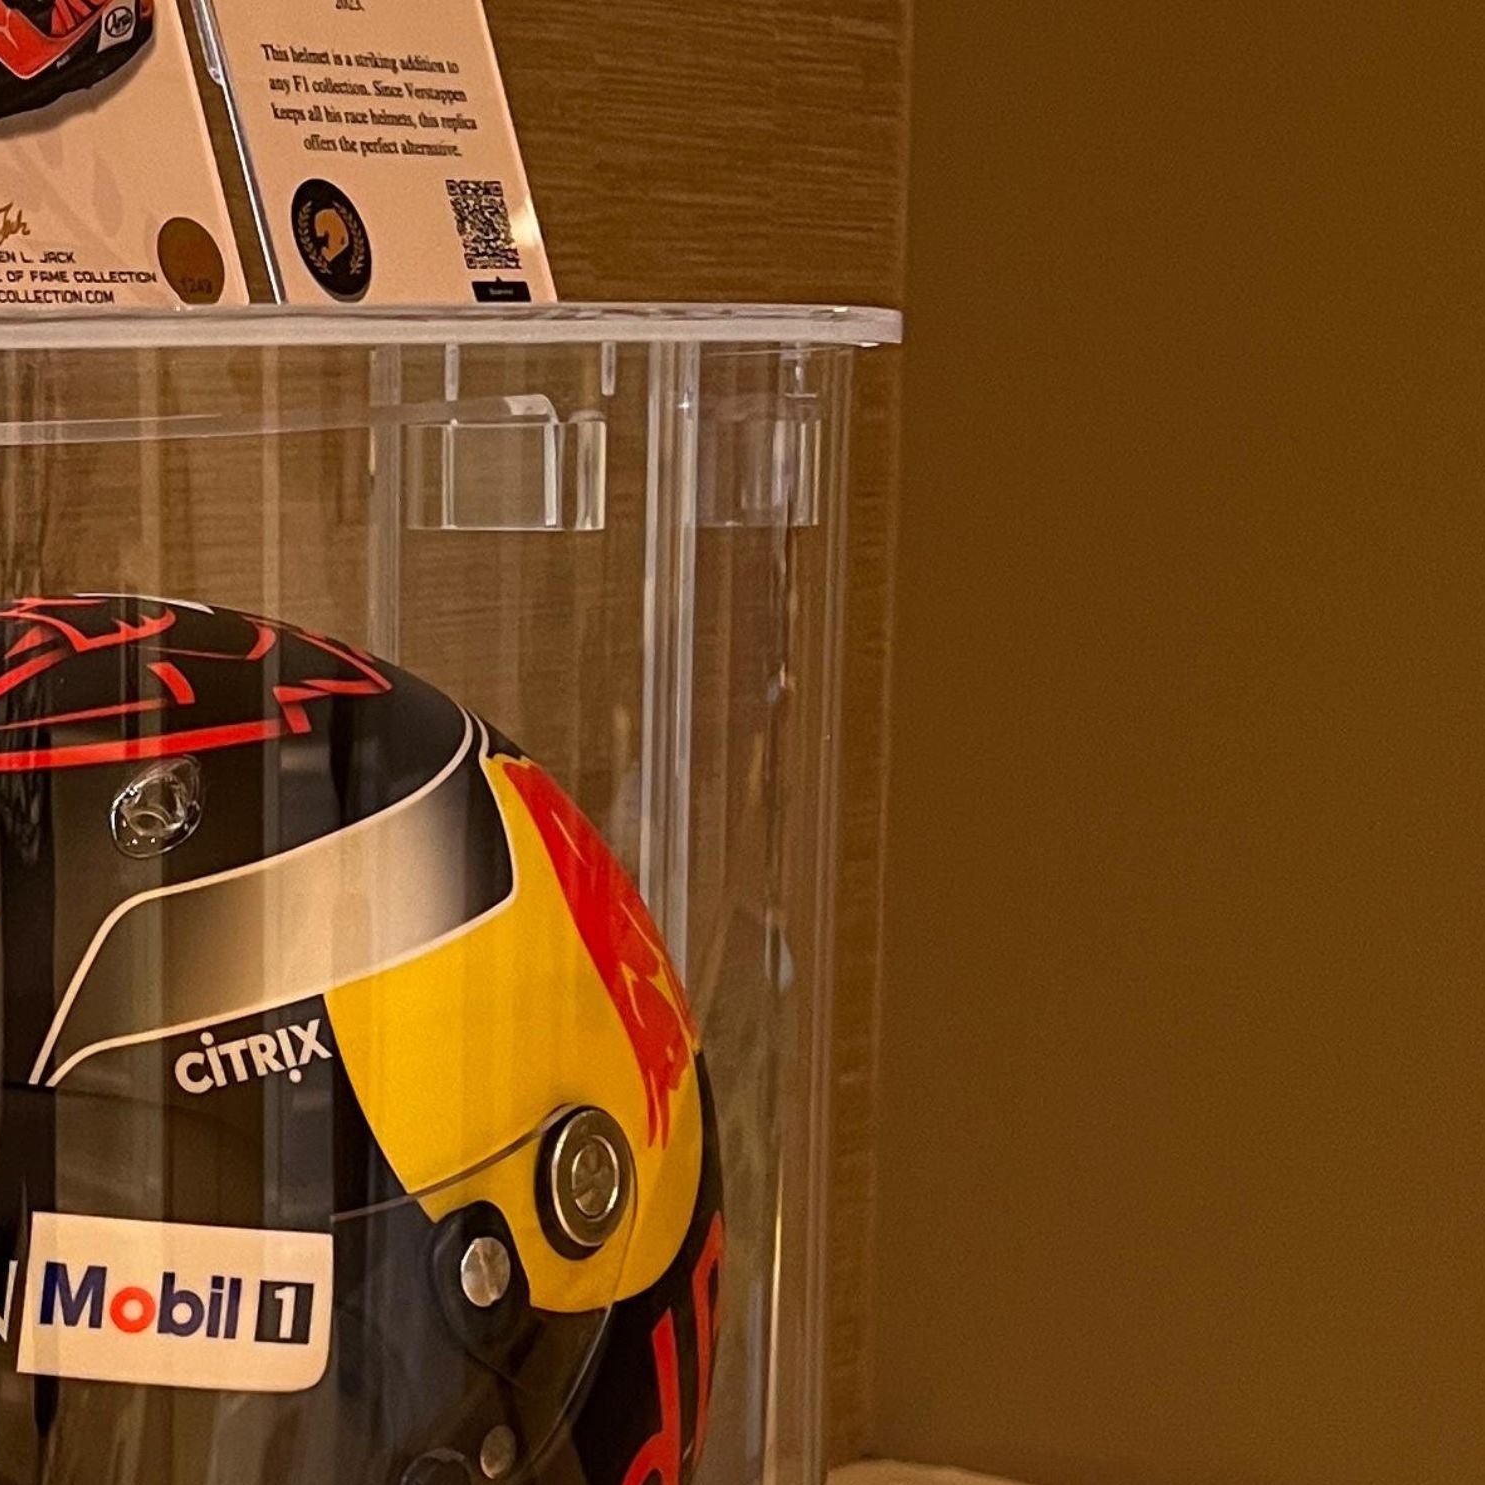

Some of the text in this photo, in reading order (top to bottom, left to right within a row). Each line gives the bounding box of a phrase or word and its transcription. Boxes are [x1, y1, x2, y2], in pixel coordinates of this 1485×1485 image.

[260, 44, 459, 75] This helmet is a striking addition to
[269, 75, 467, 105] any F1 collection. Since Verstappen
[271, 102, 477, 133] keeps all his race helmets, this replica
[303, 134, 462, 157] offers the perfect alternative.
[21, 251, 35, 263] L
[40, 251, 77, 264] JACK
[6, 270, 24, 282] OF
[30, 271, 69, 283] FAME
[73, 271, 157, 284] COLLECTION
[38, 1261, 242, 1340] Mobil
